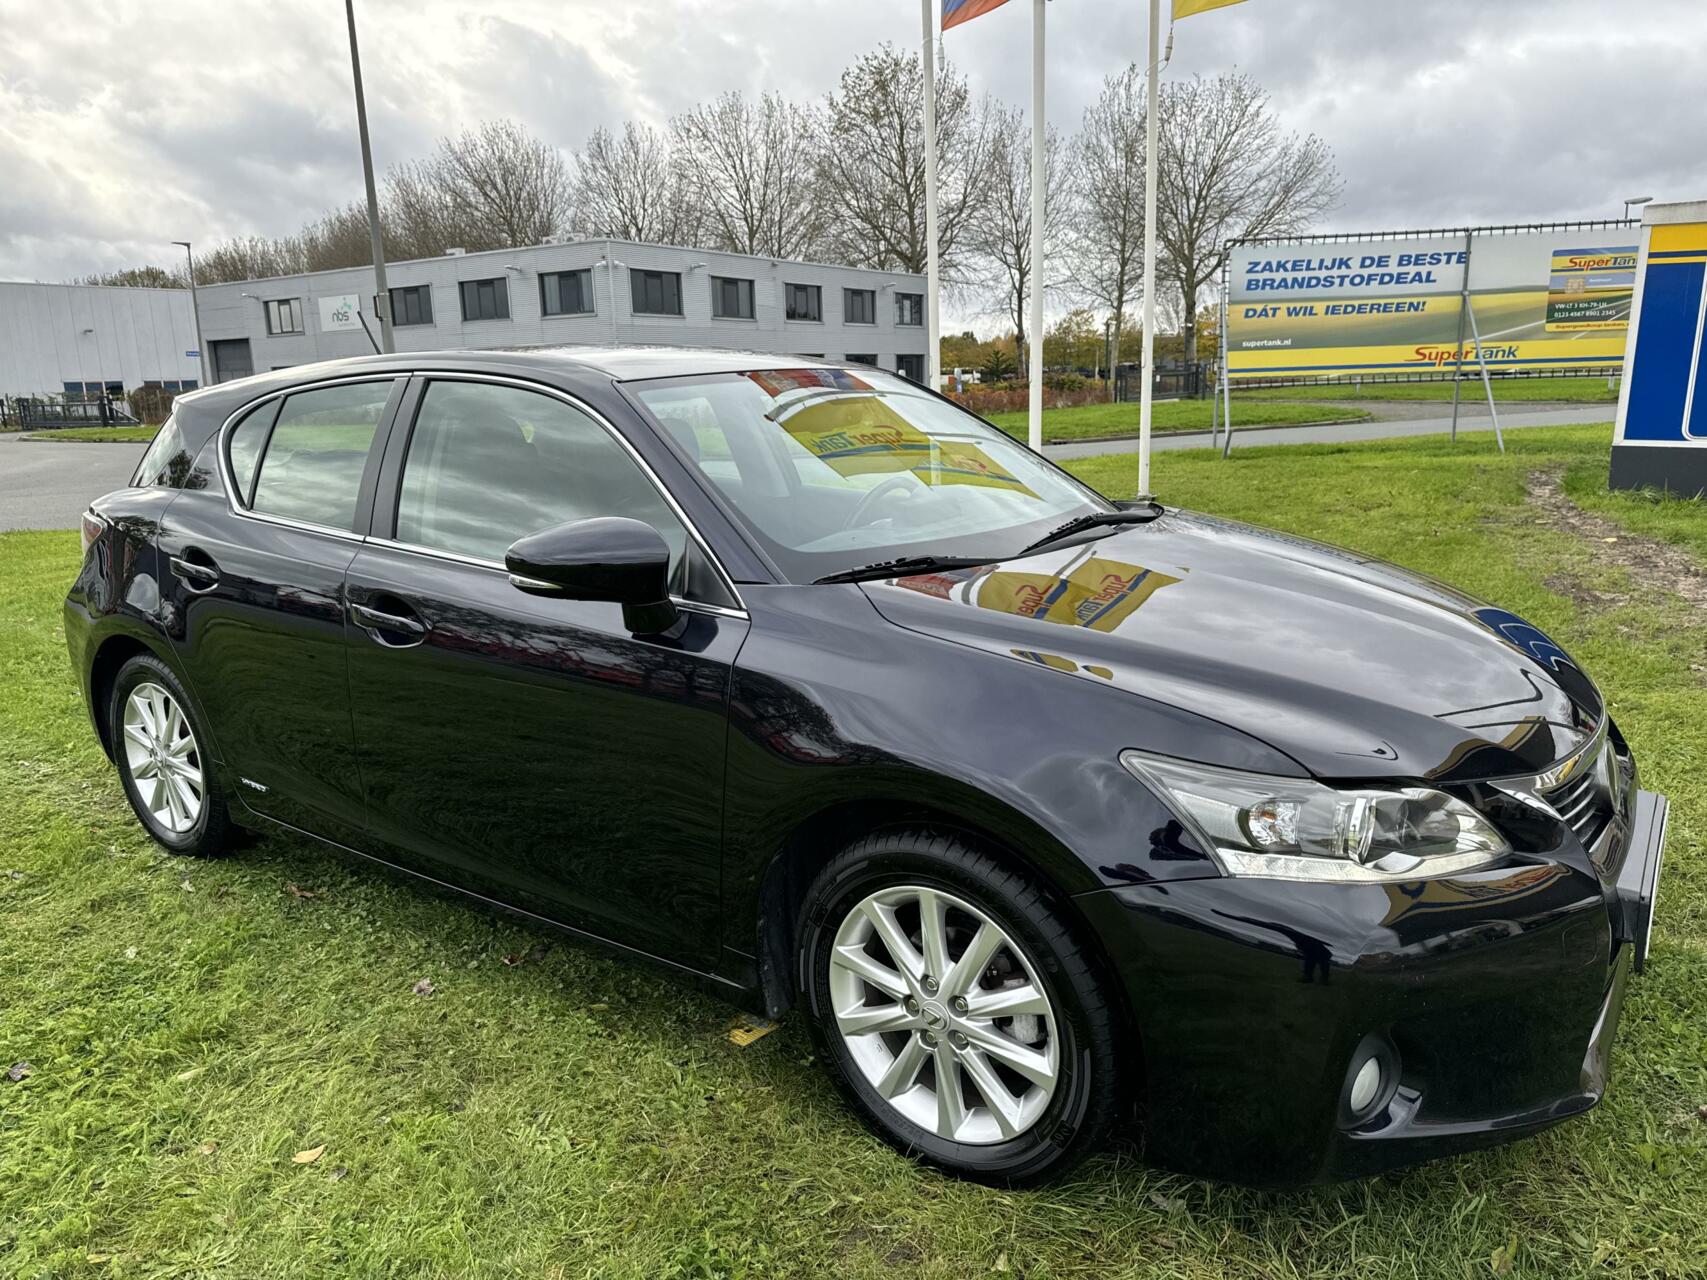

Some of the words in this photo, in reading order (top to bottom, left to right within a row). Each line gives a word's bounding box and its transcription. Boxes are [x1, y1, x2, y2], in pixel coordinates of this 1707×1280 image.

[1246, 257, 1353, 274] ZAKELIJK
[1360, 255, 1391, 269] DE
[1397, 251, 1467, 267] BESTE
[1567, 255, 1638, 271] SuperTan
[1246, 271, 1437, 291] BRANDSTOFDEAL
[1244, 305, 1280, 319] DÁT
[1286, 304, 1318, 317] WIL
[1324, 301, 1427, 316] IEDEREEN!
[1242, 339, 1291, 348] supertank.nl
